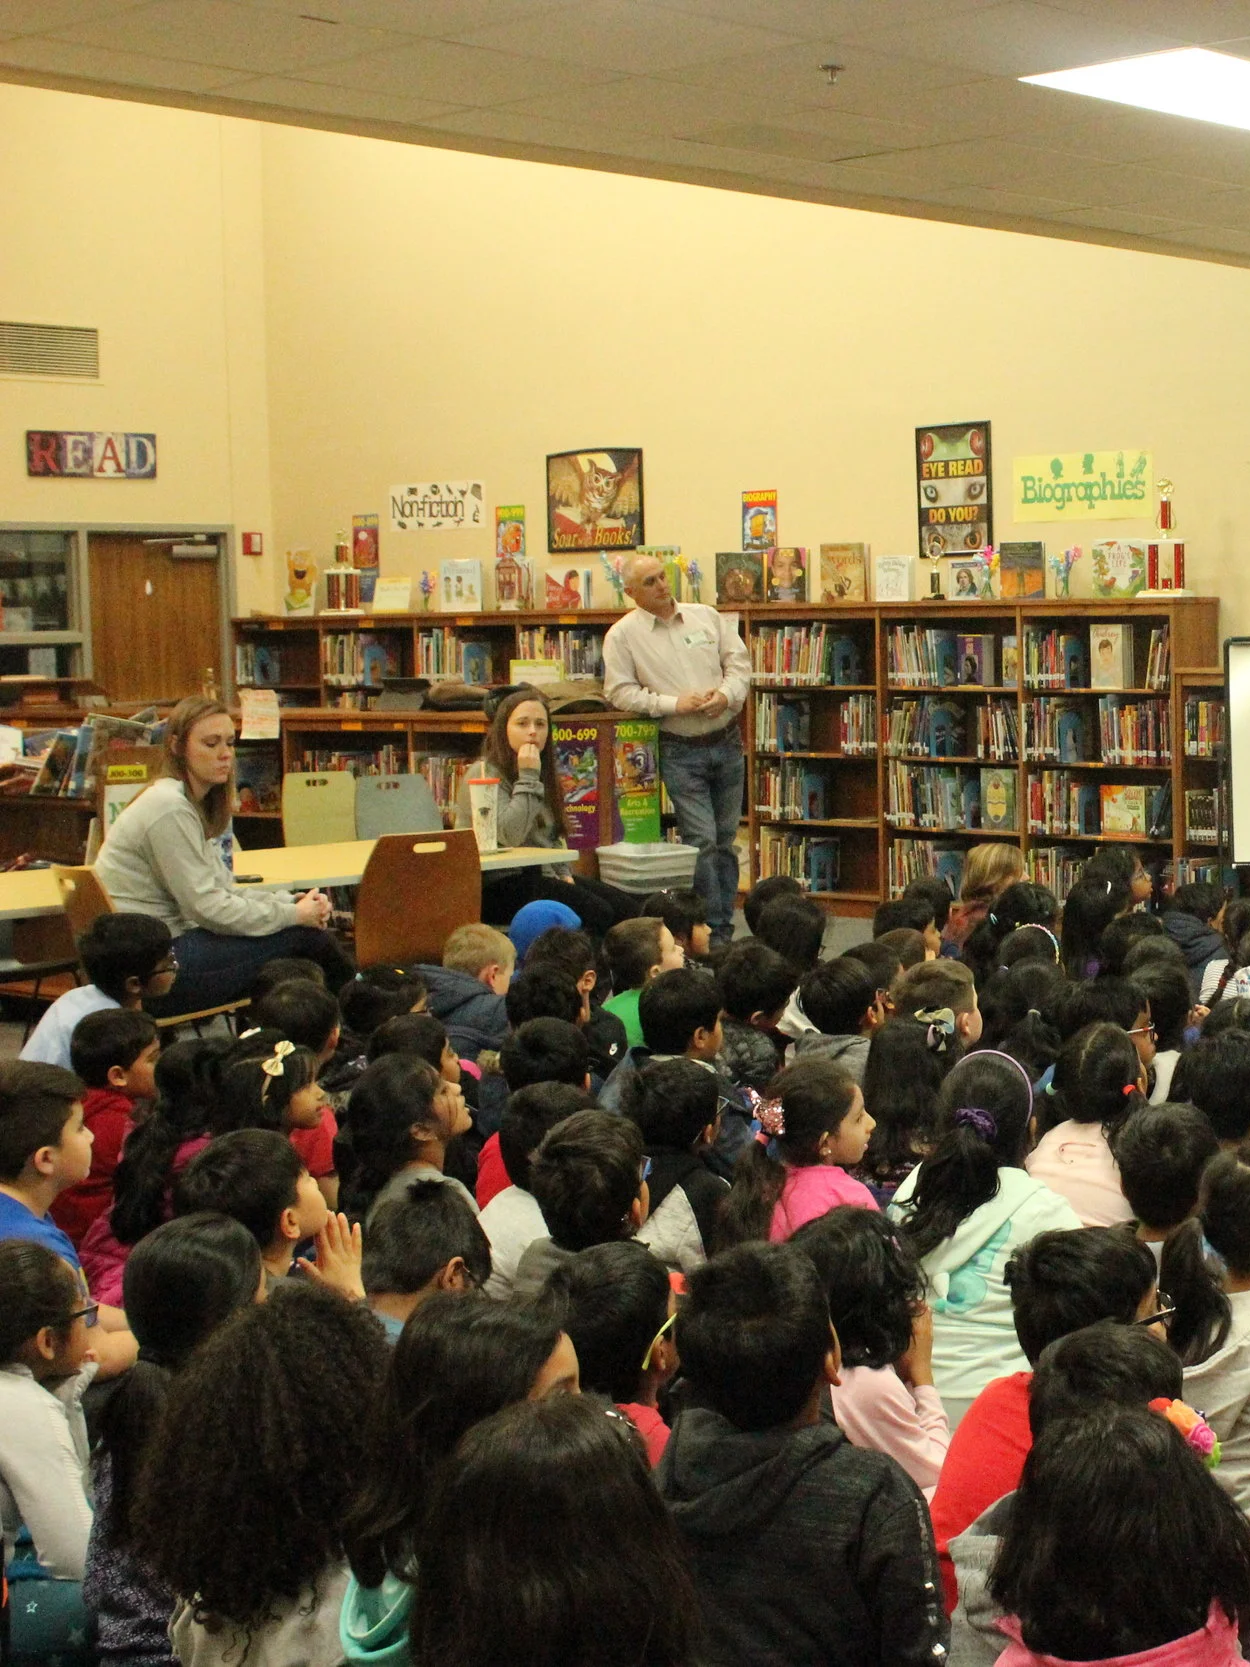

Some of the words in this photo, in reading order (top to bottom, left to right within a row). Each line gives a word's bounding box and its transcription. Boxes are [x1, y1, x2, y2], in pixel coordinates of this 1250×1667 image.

[28, 433, 156, 474] READ
[922, 461, 946, 478] EYE
[949, 459, 984, 477] READ
[742, 491, 777, 502] BIOGRAPHY
[1021, 472, 1146, 510] Biographies
[928, 508, 946, 523] DO
[948, 506, 979, 521] YOU?
[552, 528, 578, 548] Soar
[594, 524, 636, 545] Books!
[552, 728, 598, 741] 600-699
[614, 724, 656, 738] 700-799
